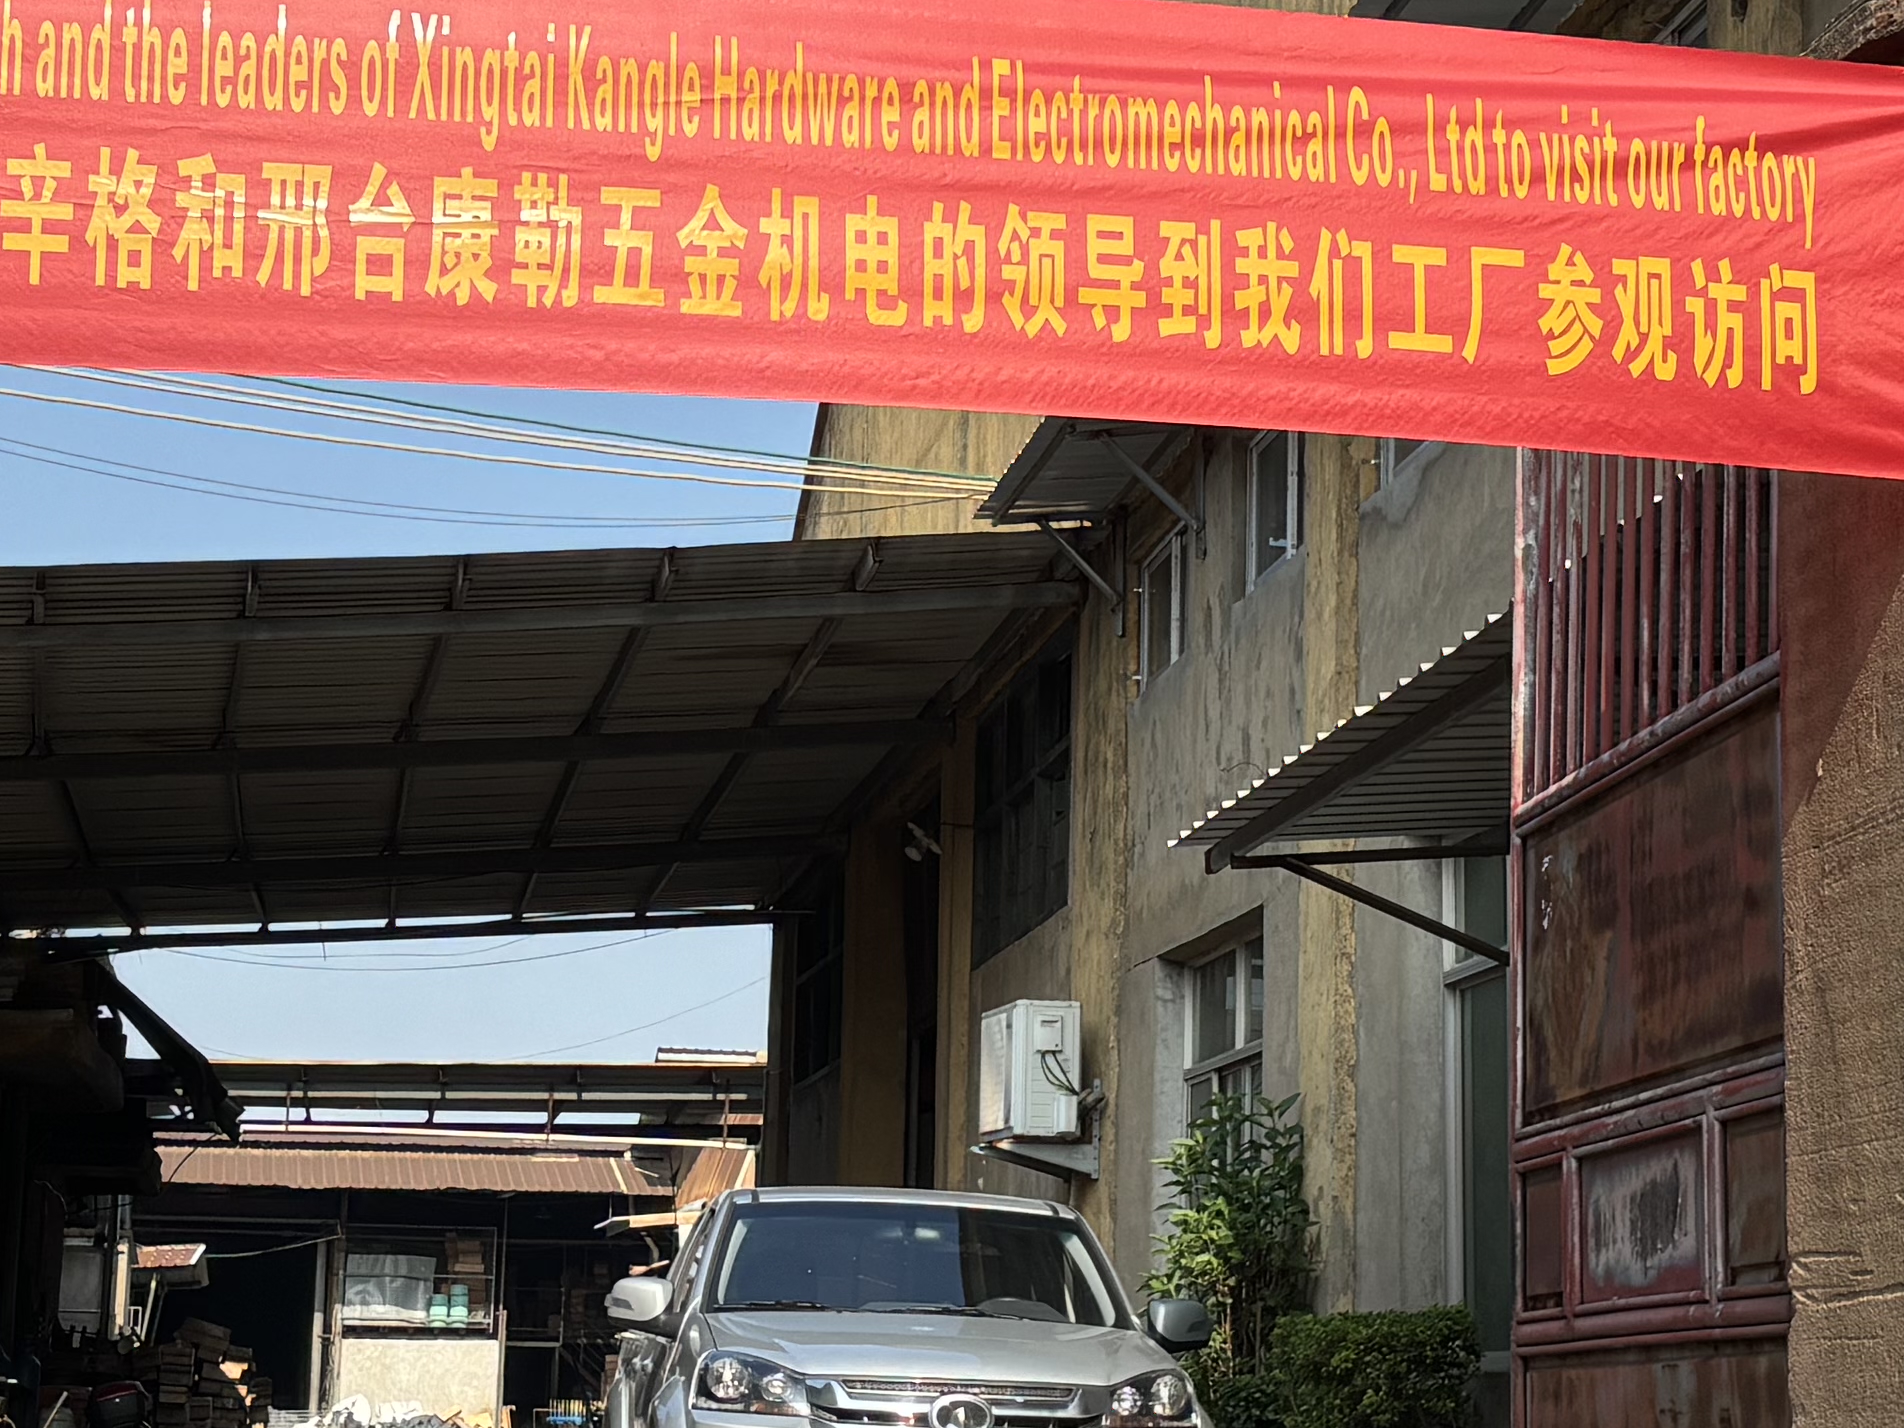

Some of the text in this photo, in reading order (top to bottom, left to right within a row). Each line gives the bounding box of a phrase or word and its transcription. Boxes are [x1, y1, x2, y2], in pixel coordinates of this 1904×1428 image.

[200, 0, 349, 116] leaders
[360, 9, 401, 118] of
[408, 12, 556, 152] Xingtai
[566, 24, 702, 163] Kangle
[713, 35, 901, 153] Hardware
[911, 56, 981, 158] and
[991, 58, 1338, 184] Electromechanical
[1425, 93, 1486, 196] Ltd
[1492, 110, 1532, 200] to
[1539, 104, 1619, 208] visit
[1627, 138, 1686, 213] our
[1693, 115, 1816, 250] factory
